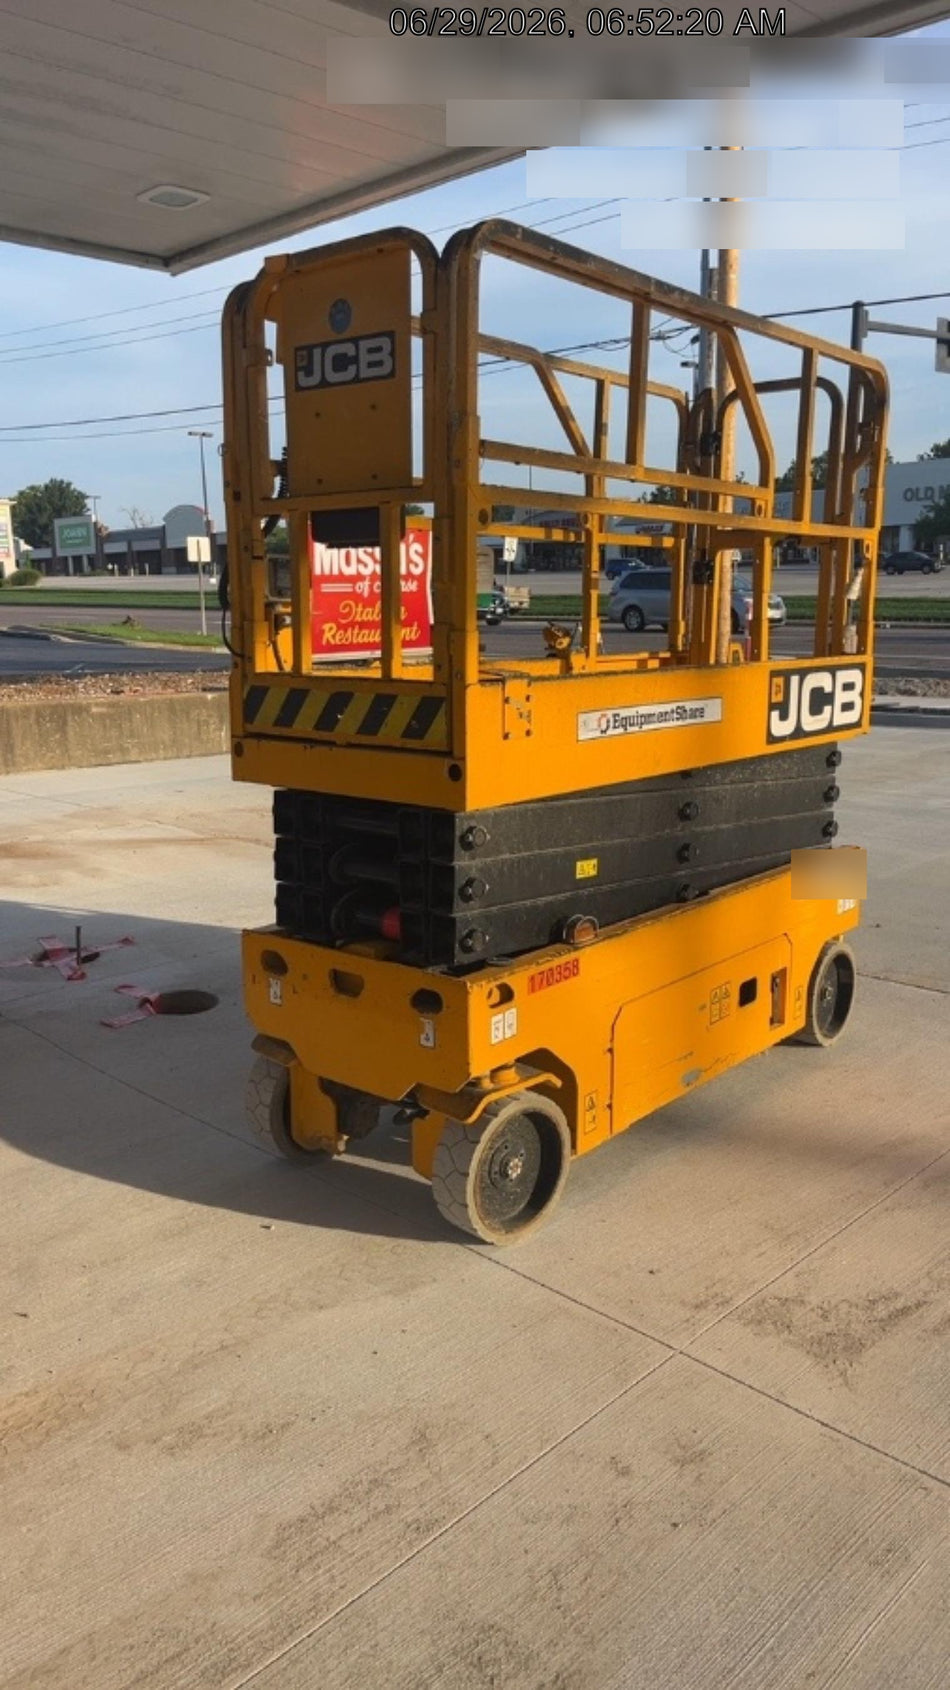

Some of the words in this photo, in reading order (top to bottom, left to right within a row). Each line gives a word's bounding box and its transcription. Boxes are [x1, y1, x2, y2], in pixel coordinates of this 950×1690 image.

[297, 336, 393, 388] JCB
[904, 486, 934, 501] OLD
[354, 576, 371, 598] of
[373, 580, 418, 593] crse
[338, 600, 408, 624] Italn
[322, 623, 421, 646] Restaunt
[770, 668, 863, 738] JCB
[611, 705, 705, 731] EquipmentShare
[529, 958, 579, 994] 170358
